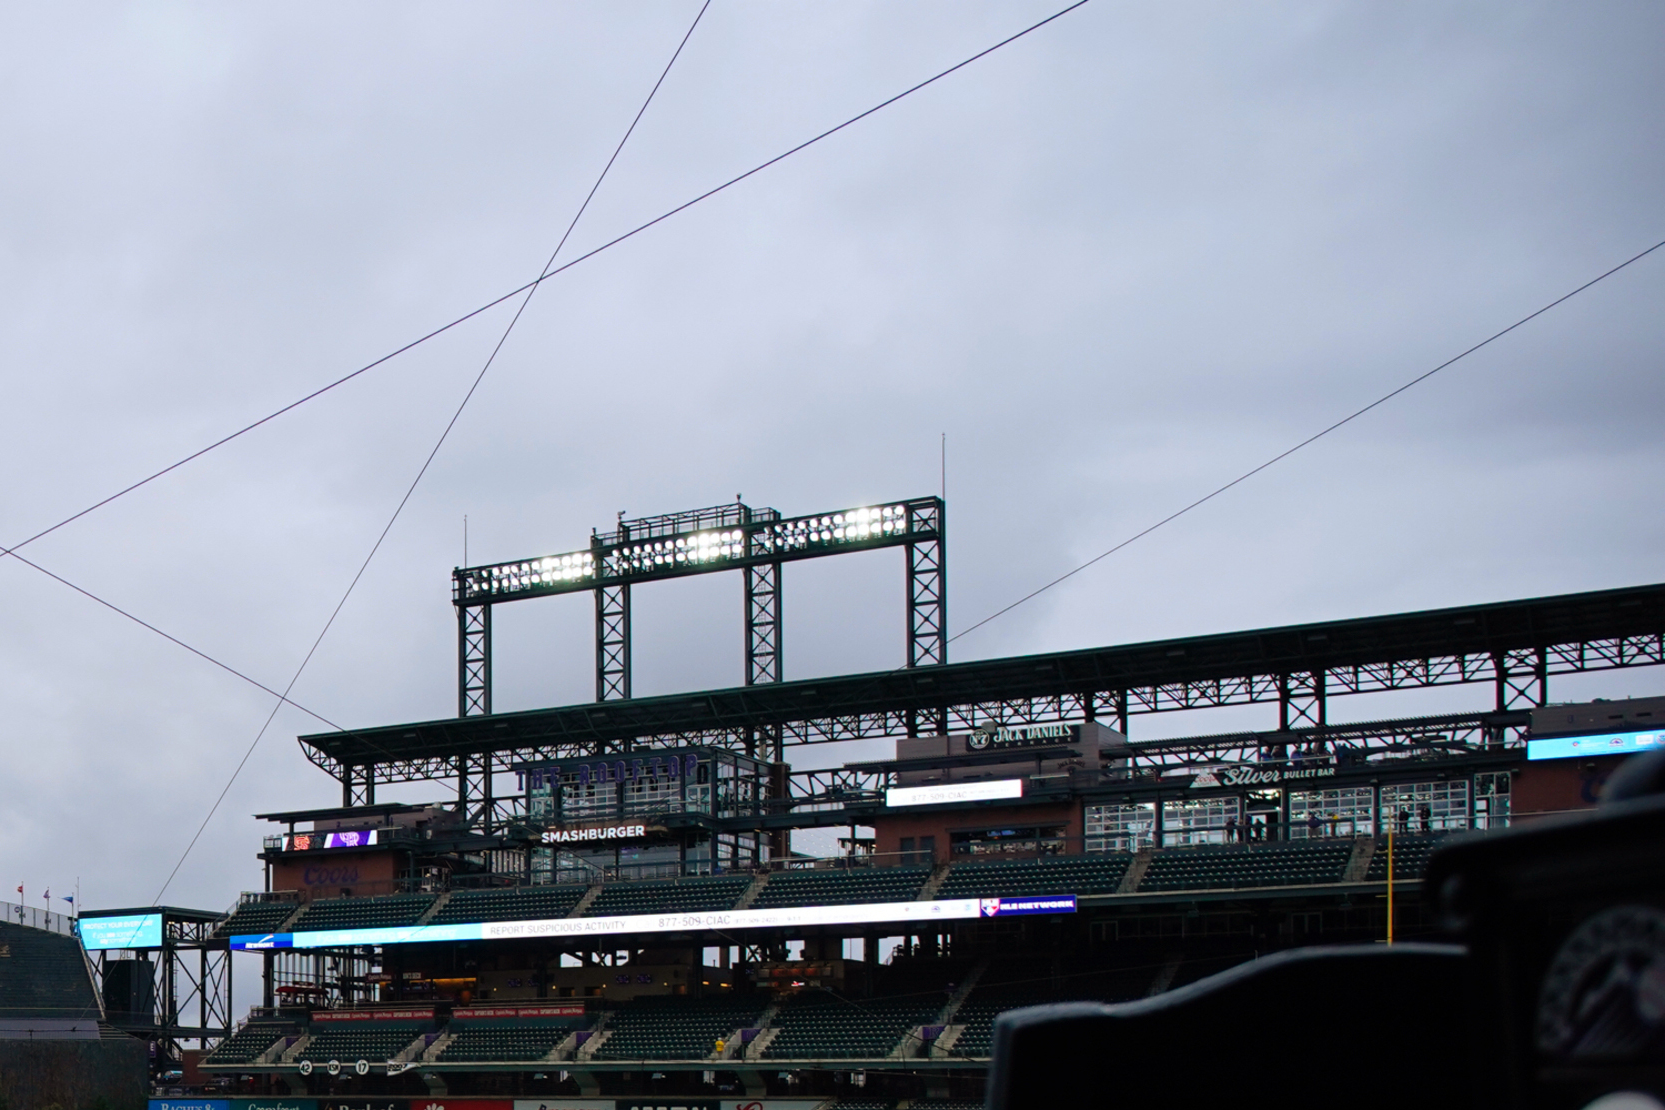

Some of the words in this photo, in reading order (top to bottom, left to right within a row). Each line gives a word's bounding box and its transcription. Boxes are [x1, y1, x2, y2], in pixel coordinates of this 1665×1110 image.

[993, 726, 1024, 743] JACK
[516, 766, 561, 791] THE
[579, 753, 698, 786] ROOFTOP
[1222, 768, 1281, 786] Silver
[1283, 768, 1316, 779] BULLET
[1317, 767, 1335, 776] BAR
[541, 825, 646, 844] SMASHBURGER
[304, 866, 359, 885] Coors
[1018, 900, 1074, 909] NETWORK
[490, 925, 524, 935] REPORT
[527, 923, 583, 934] SUSPICIOUS
[585, 921, 626, 931] ACTIVITY
[658, 914, 731, 928] 877-509-CIAC
[300, 1063, 310, 1073] 42
[358, 1063, 366, 1073] 17
